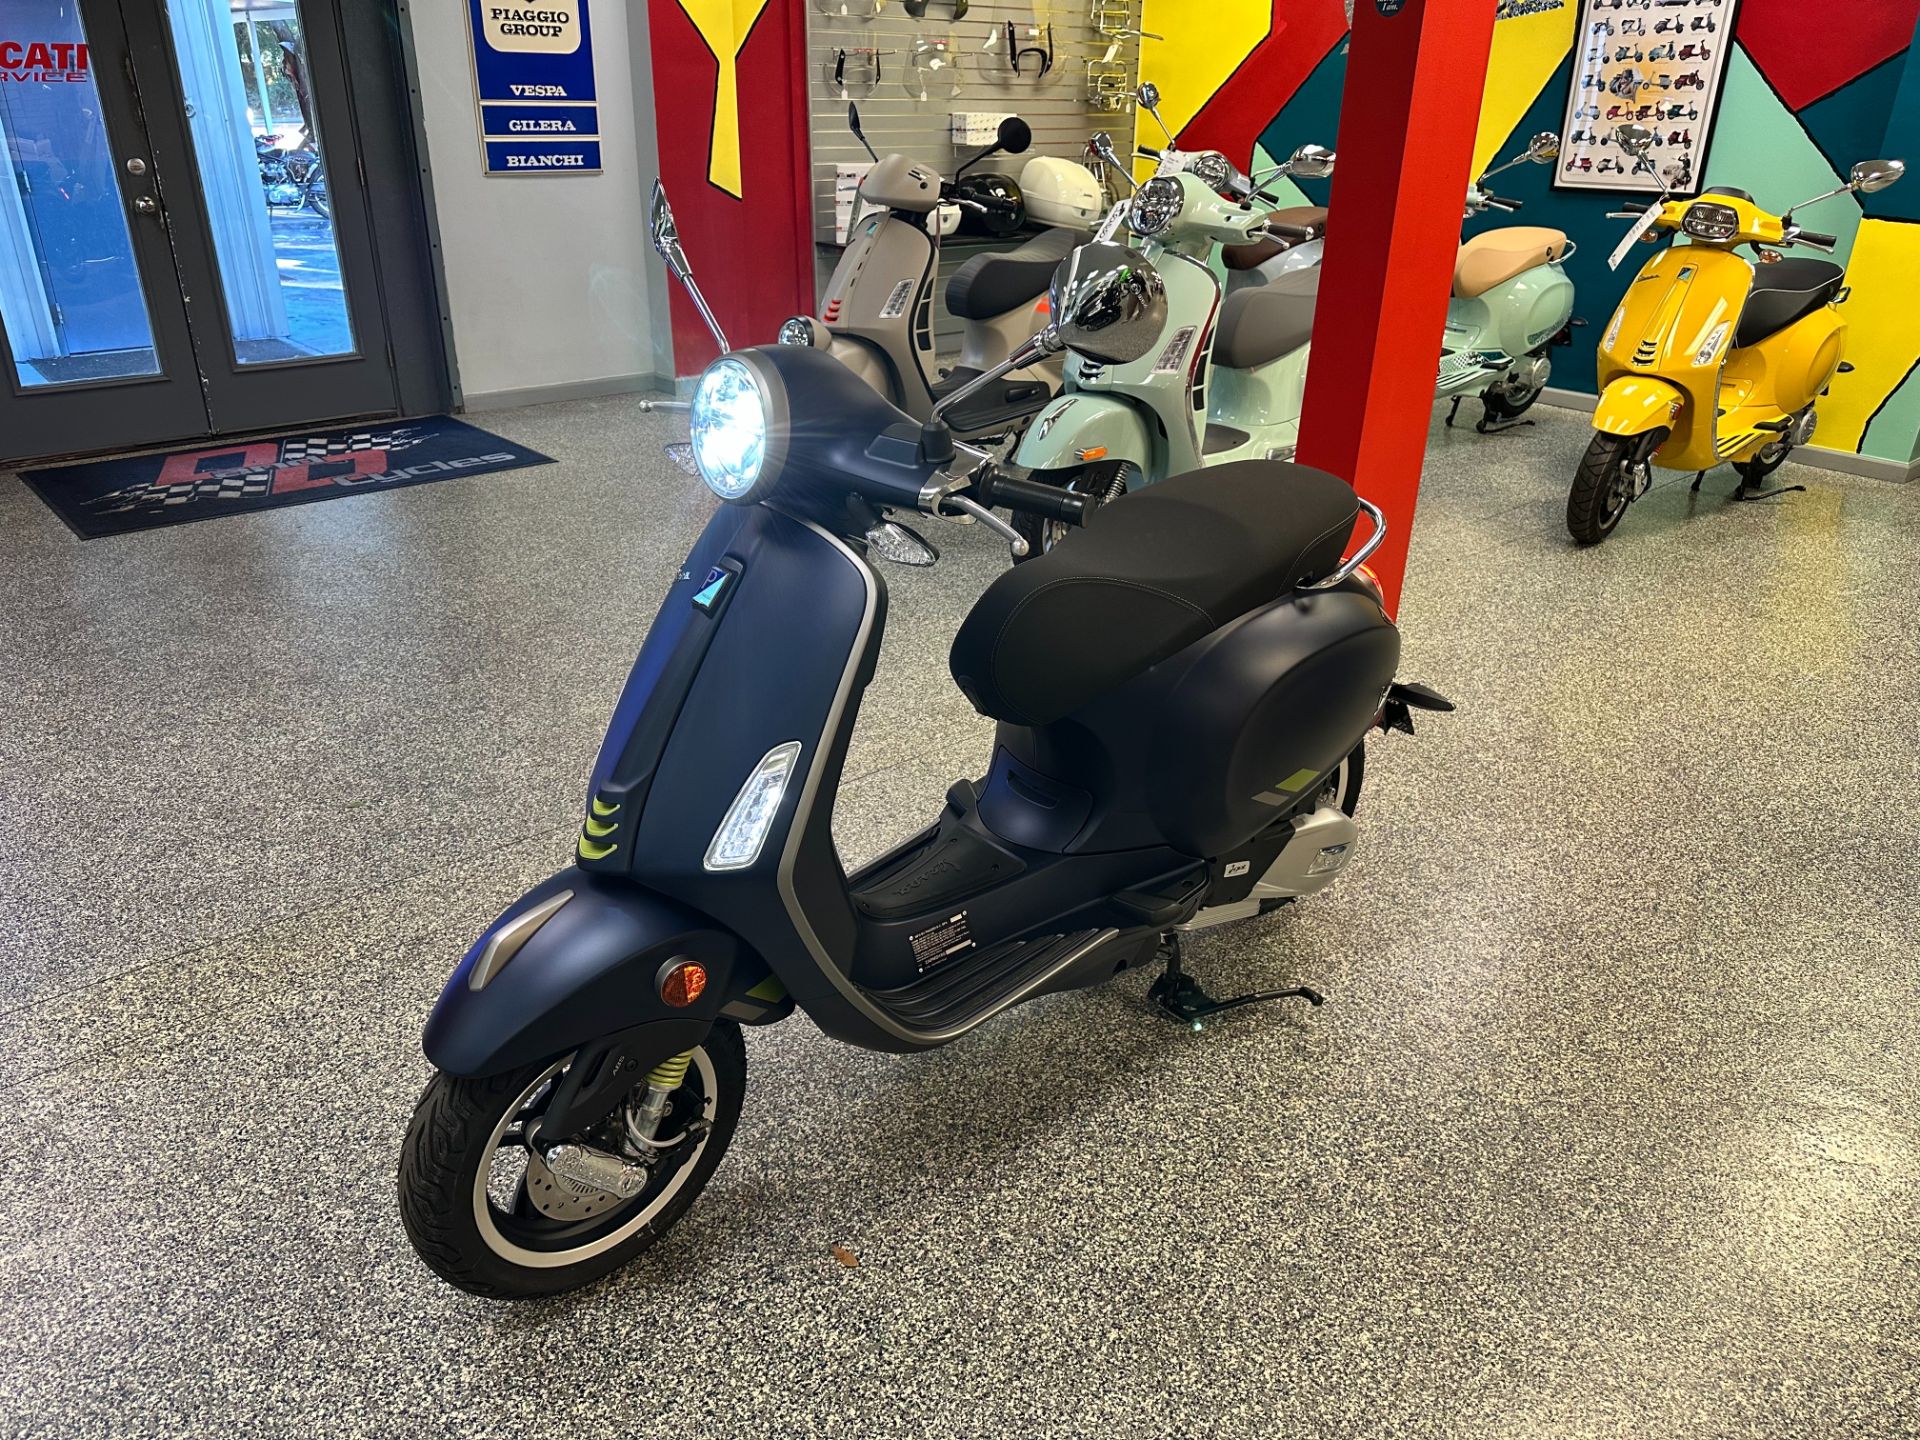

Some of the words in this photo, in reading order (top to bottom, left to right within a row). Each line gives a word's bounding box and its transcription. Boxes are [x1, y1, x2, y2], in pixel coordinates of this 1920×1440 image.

[491, 8, 569, 24] PIAGGIO
[500, 23, 562, 37] GROUP
[510, 84, 567, 97] VESPA
[508, 119, 576, 131] GILERA
[506, 154, 584, 167] BIANCHI
